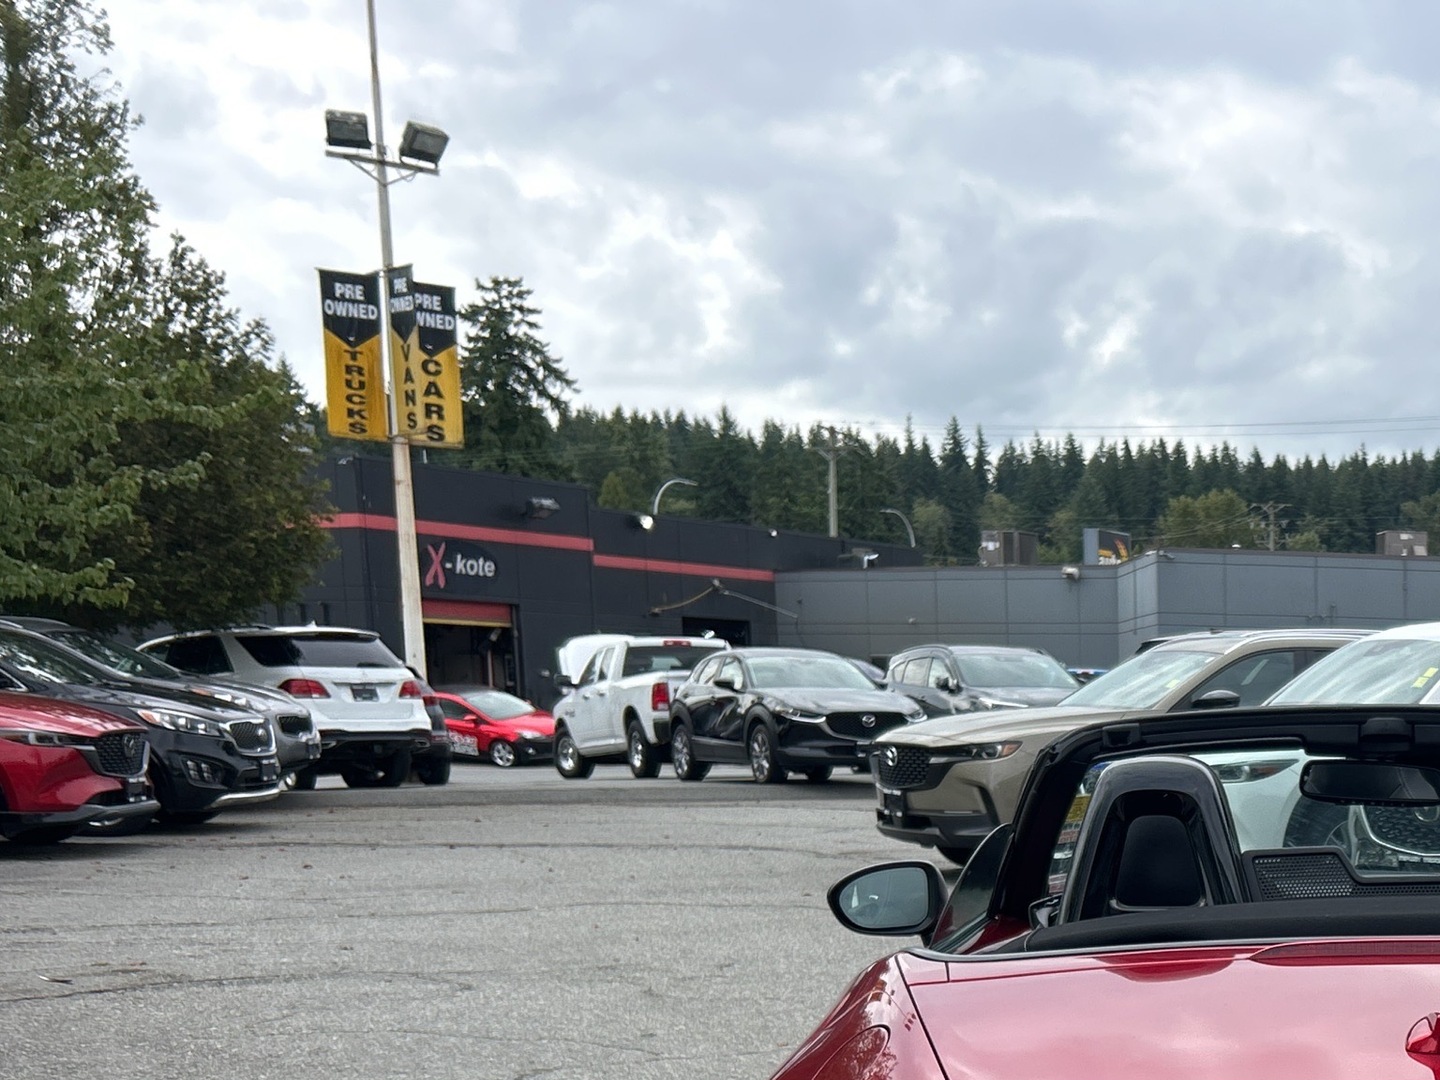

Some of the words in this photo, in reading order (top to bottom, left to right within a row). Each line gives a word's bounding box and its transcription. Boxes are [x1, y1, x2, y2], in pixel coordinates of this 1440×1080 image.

[324, 298, 379, 320] OWNED
[334, 282, 366, 301] PRE
[414, 293, 442, 312] PRE
[344, 349, 368, 434] TRUCKS
[401, 344, 417, 430] VANS
[421, 359, 445, 442] CARS
